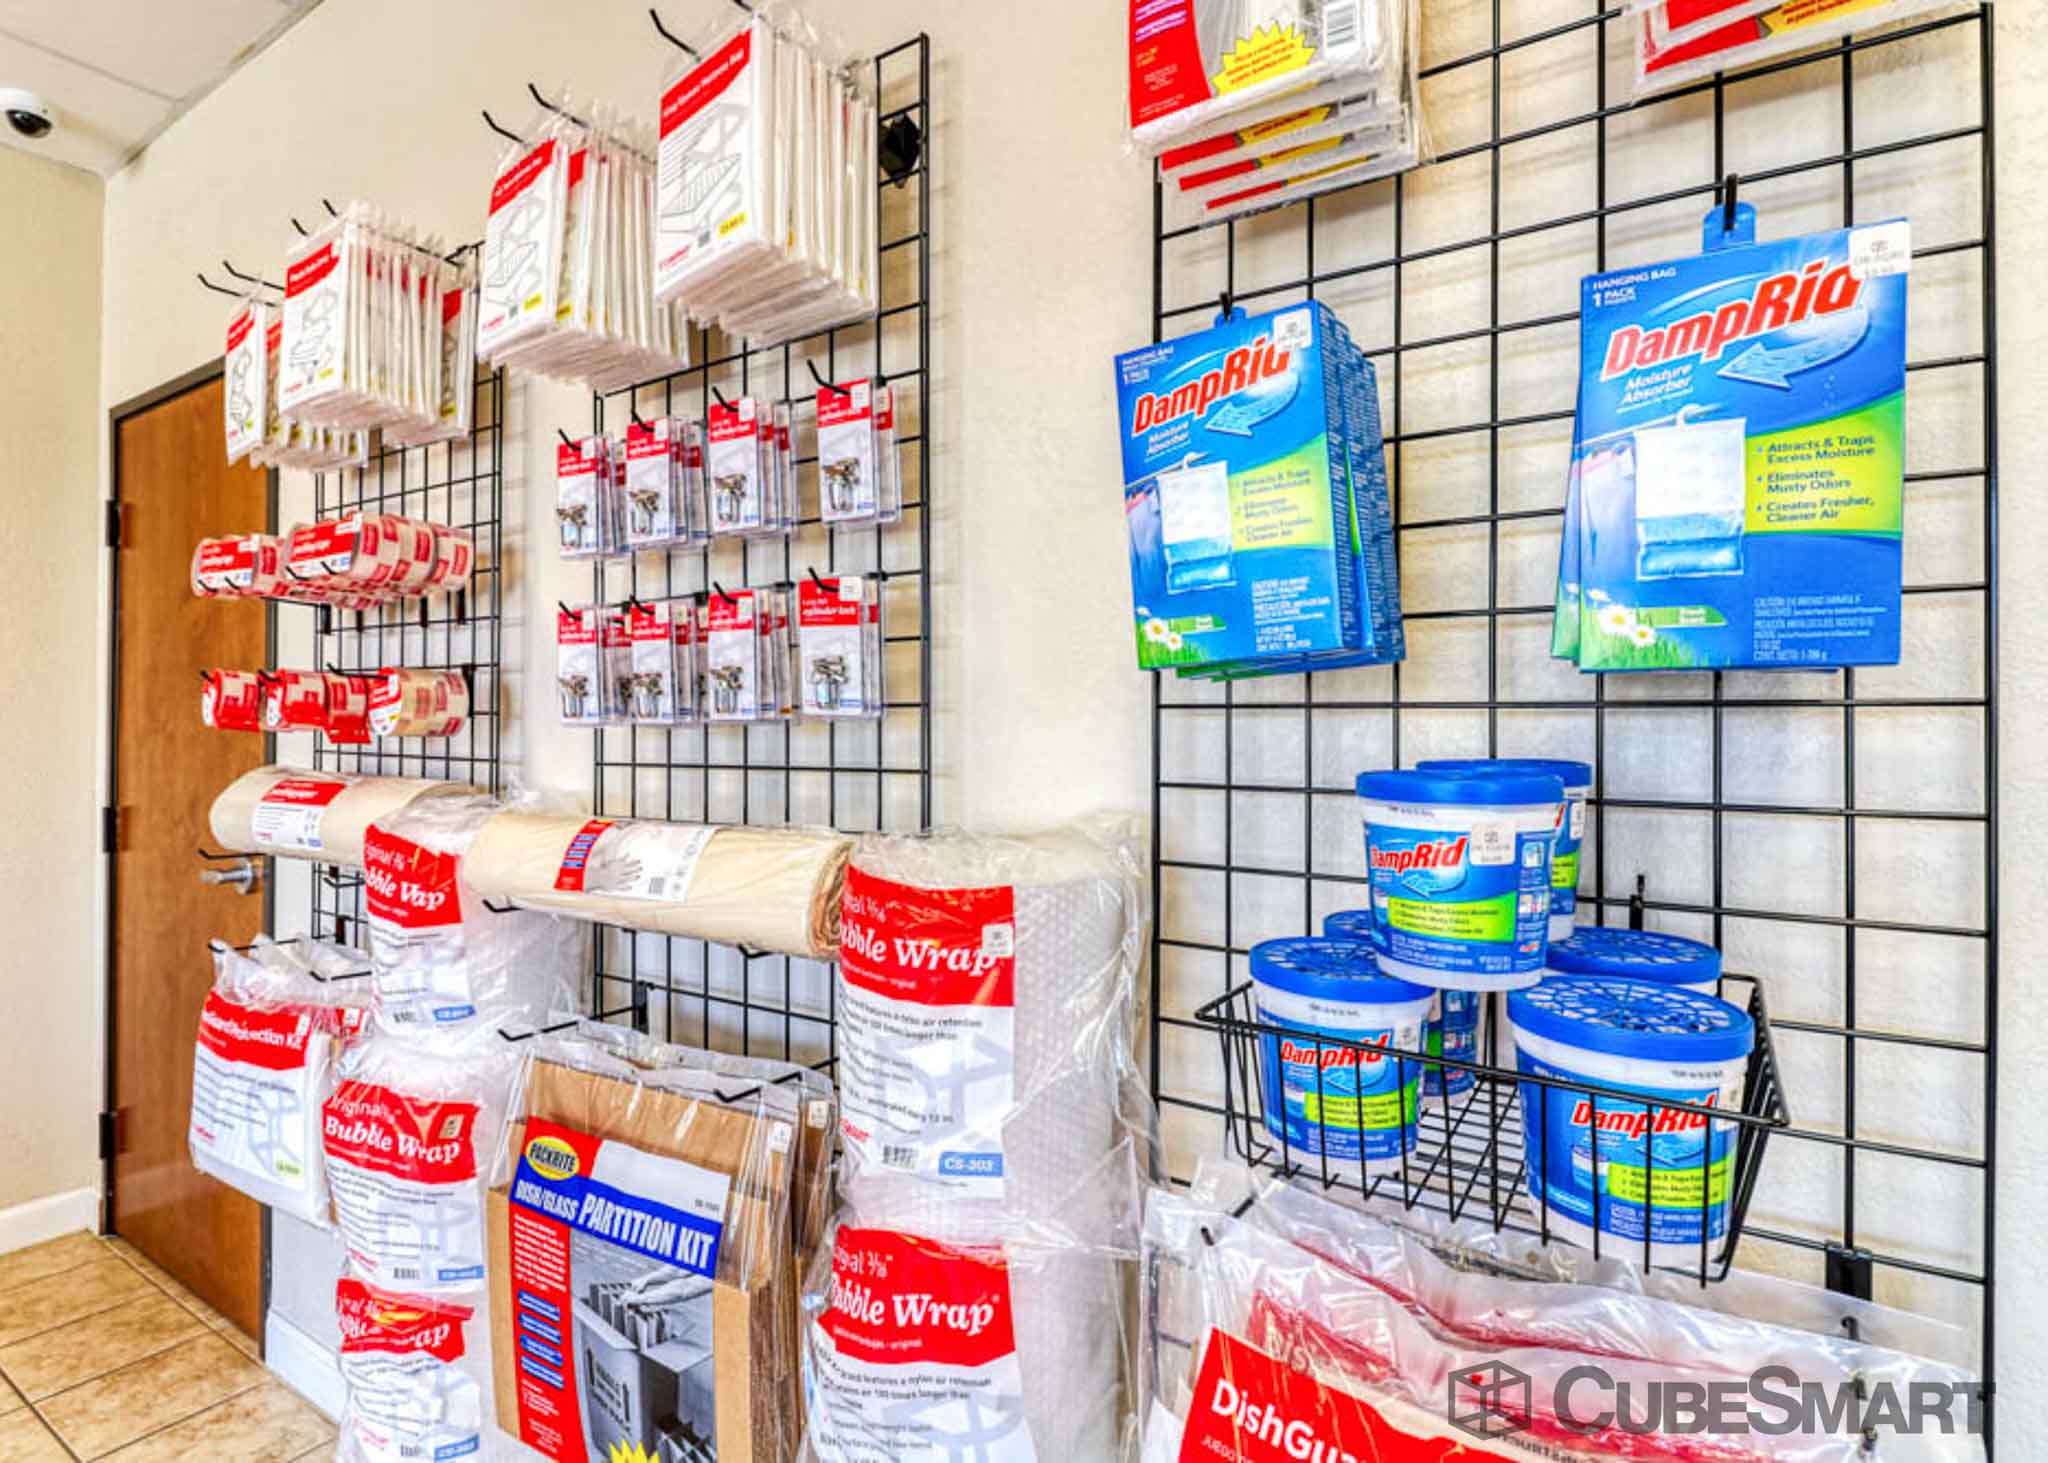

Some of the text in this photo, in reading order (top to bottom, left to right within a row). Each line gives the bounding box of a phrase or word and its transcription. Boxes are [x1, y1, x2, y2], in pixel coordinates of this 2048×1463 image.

[1593, 267, 1677, 290] HANGING BAG
[1593, 288, 1637, 308] 1 PACK
[1626, 364, 1693, 392] Moisture
[1623, 378, 1693, 404] Absorber
[1767, 435, 1876, 454] Attracts & Traps
[1767, 445, 1876, 465] Excess Moisture
[1767, 469, 1835, 484] Eliminates
[1767, 477, 1852, 495] Musty Odors
[1766, 499, 1818, 514] Creates
[1766, 508, 1841, 524] Cleaner Air
[839, 915, 996, 976] ubble Wrap
[578, 1192, 677, 1258] PARTITION
[675, 1226, 715, 1270] KIT
[892, 1293, 994, 1336] Wrap
